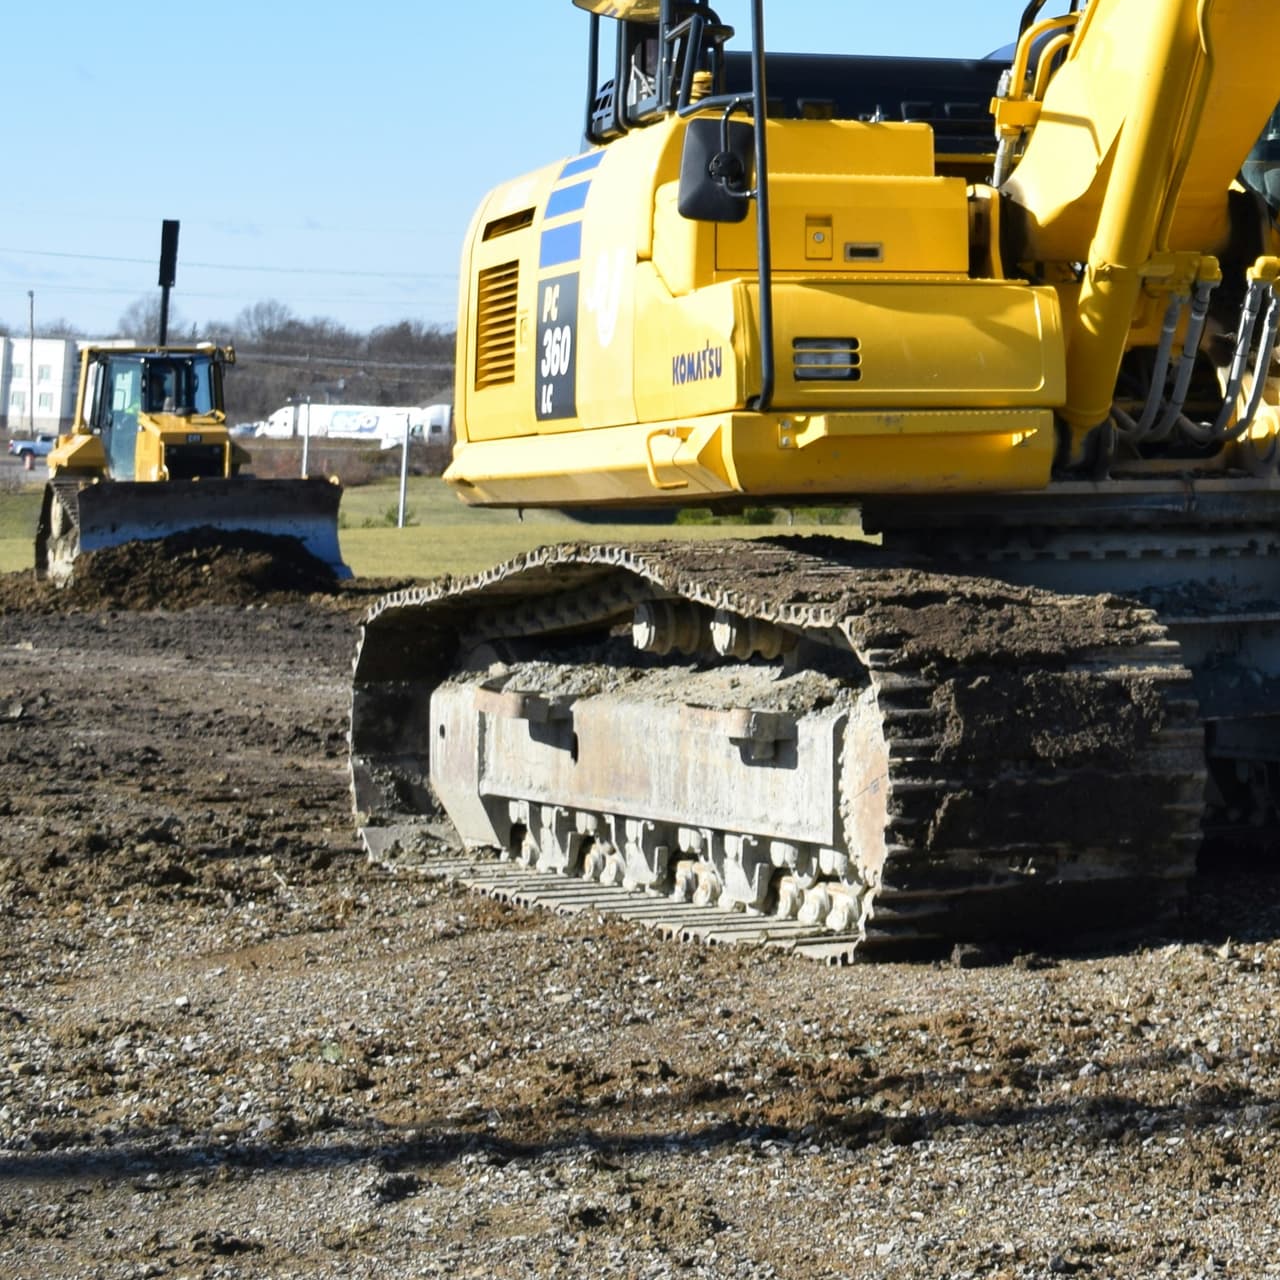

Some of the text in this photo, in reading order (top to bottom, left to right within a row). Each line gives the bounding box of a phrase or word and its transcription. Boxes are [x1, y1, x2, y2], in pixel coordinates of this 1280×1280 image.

[542, 283, 560, 323] PC
[541, 325, 571, 378] 360
[672, 339, 722, 385] KOMATSU
[541, 383, 553, 414] LC
